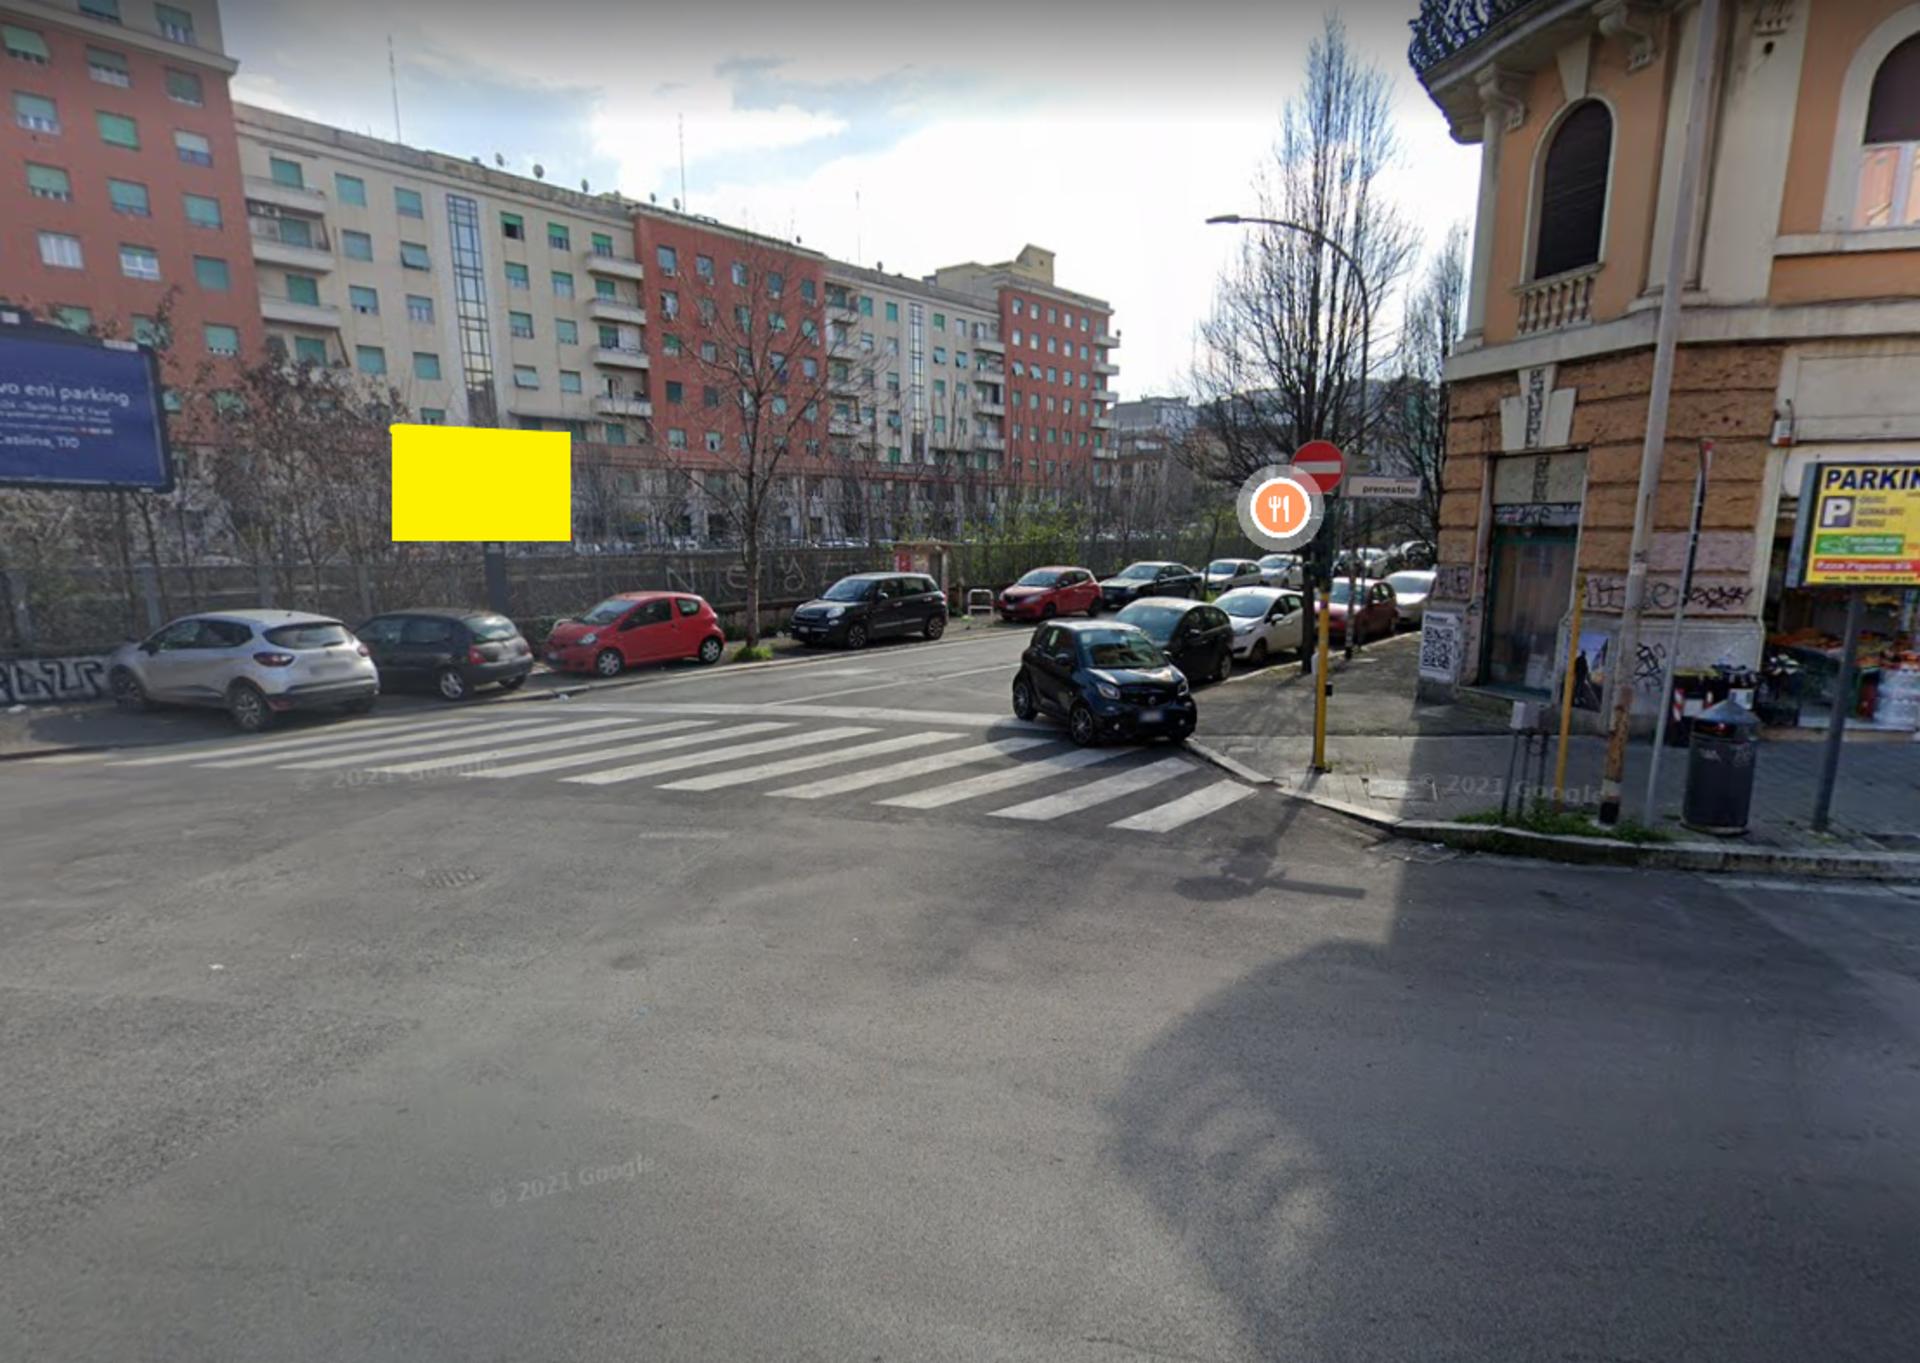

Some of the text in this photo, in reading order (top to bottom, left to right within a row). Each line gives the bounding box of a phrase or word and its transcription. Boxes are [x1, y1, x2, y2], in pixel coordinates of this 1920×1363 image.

[24, 383, 56, 397] eni
[60, 387, 130, 407] parking
[1362, 484, 1418, 494] prenestino
[1824, 468, 1920, 490] PARKIN
